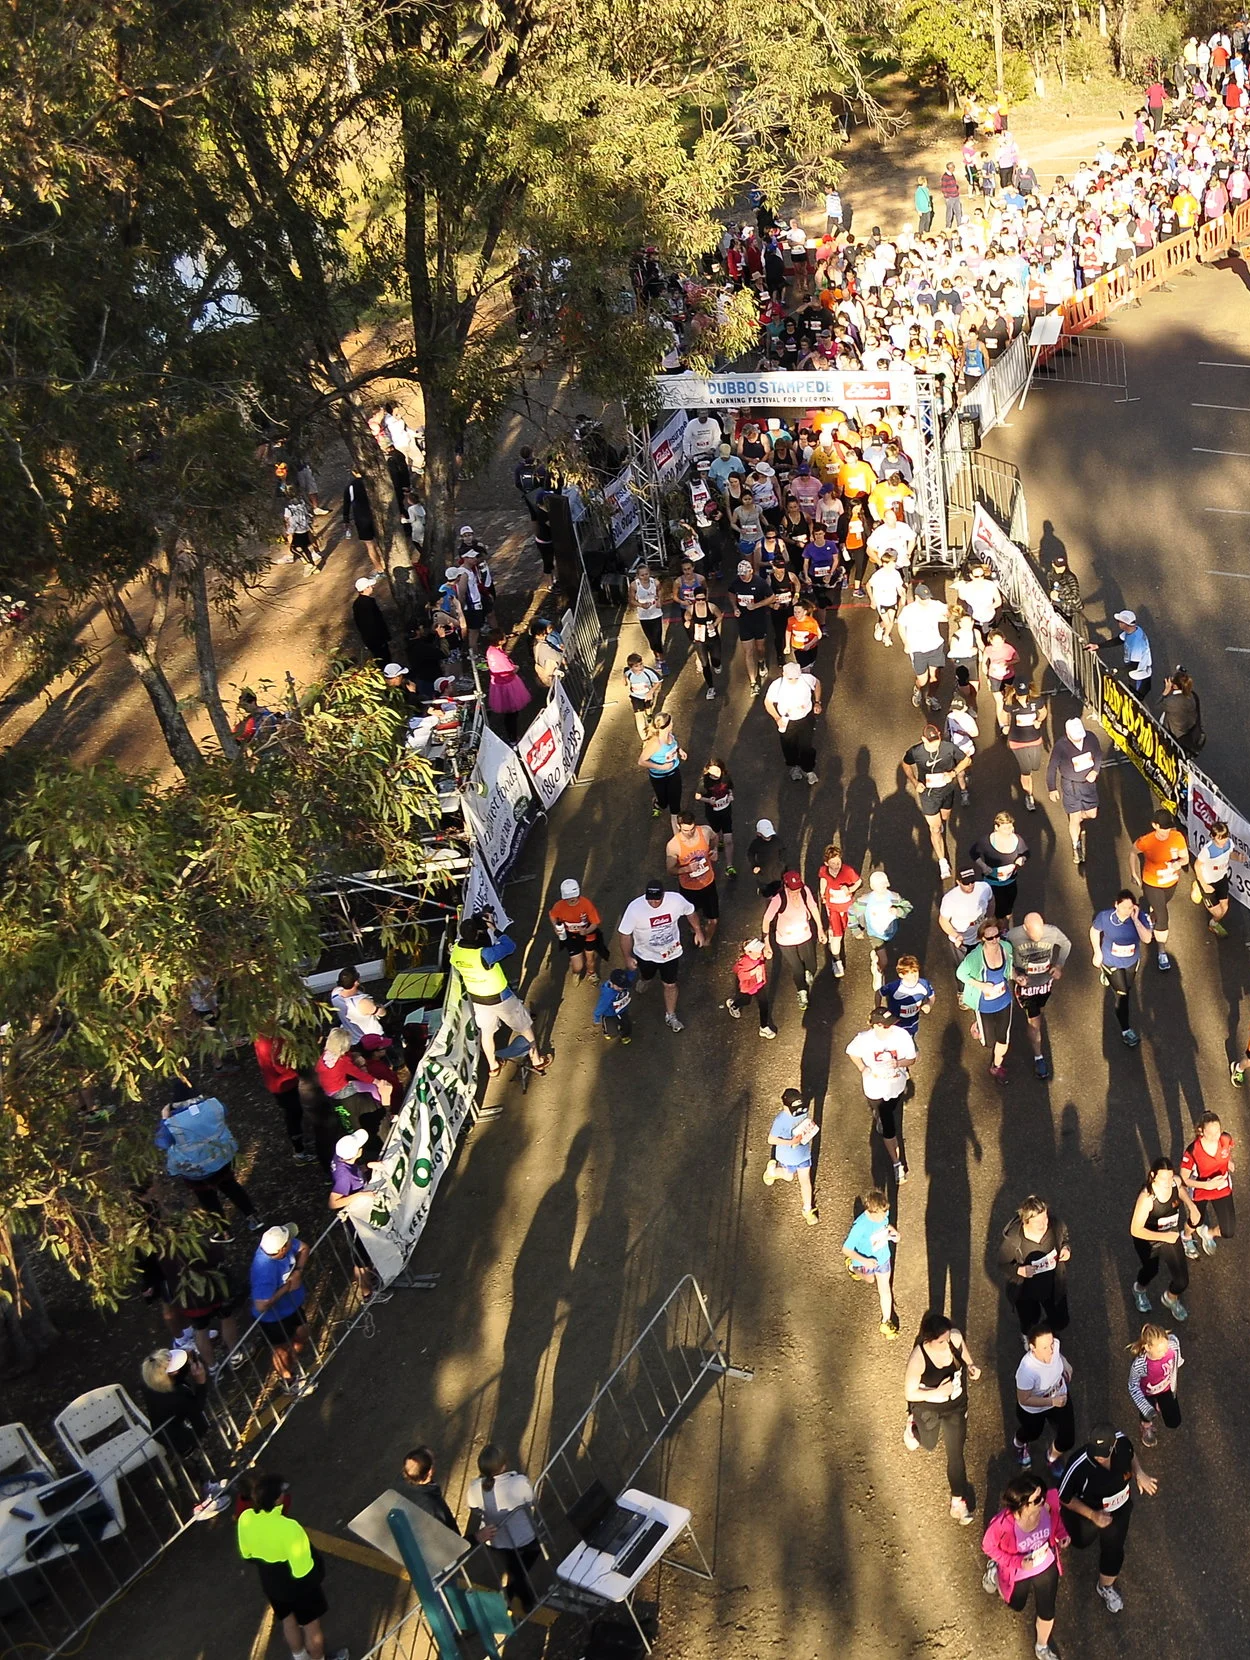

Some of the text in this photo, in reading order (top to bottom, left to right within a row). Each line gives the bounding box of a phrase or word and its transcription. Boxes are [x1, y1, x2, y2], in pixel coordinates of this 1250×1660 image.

[708, 381, 832, 395] DUBBO STAMPEDE
[495, 765, 519, 803] foods
[541, 766, 561, 800] 1800
[1018, 1528, 1050, 1551] PARIS
